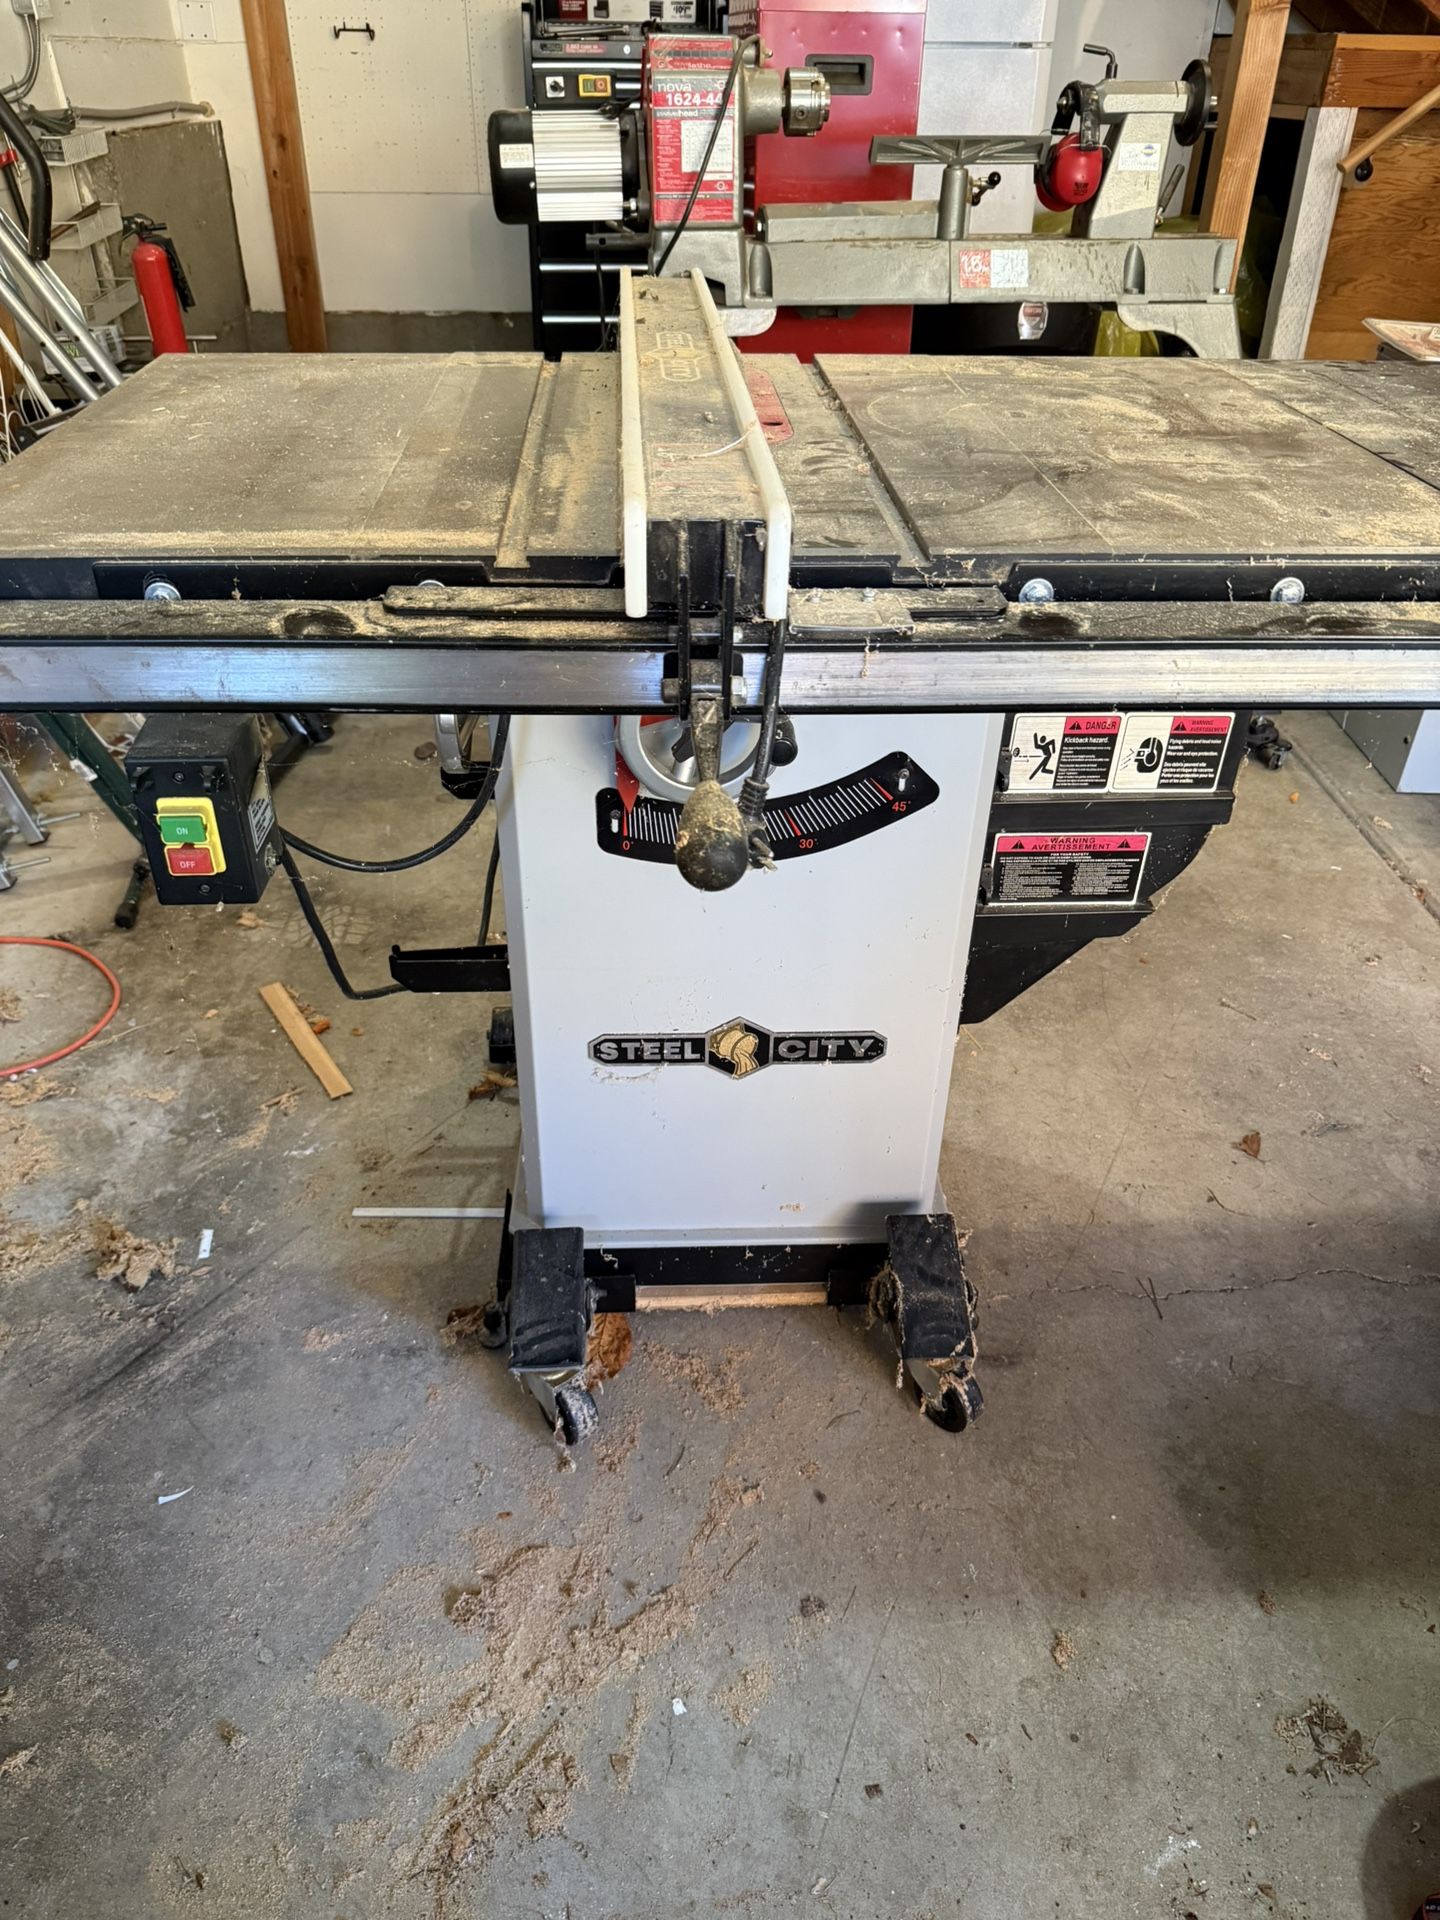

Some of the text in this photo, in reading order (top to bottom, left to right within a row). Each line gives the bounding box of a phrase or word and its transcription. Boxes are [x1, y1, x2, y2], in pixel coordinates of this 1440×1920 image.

[658, 82, 691, 92] nova
[176, 827, 189, 836] ON
[1031, 843, 1111, 851] AVERTISSEMENT
[180, 860, 195, 869] OFF
[600, 1041, 700, 1060] STEEL
[778, 1039, 874, 1058] CITY
